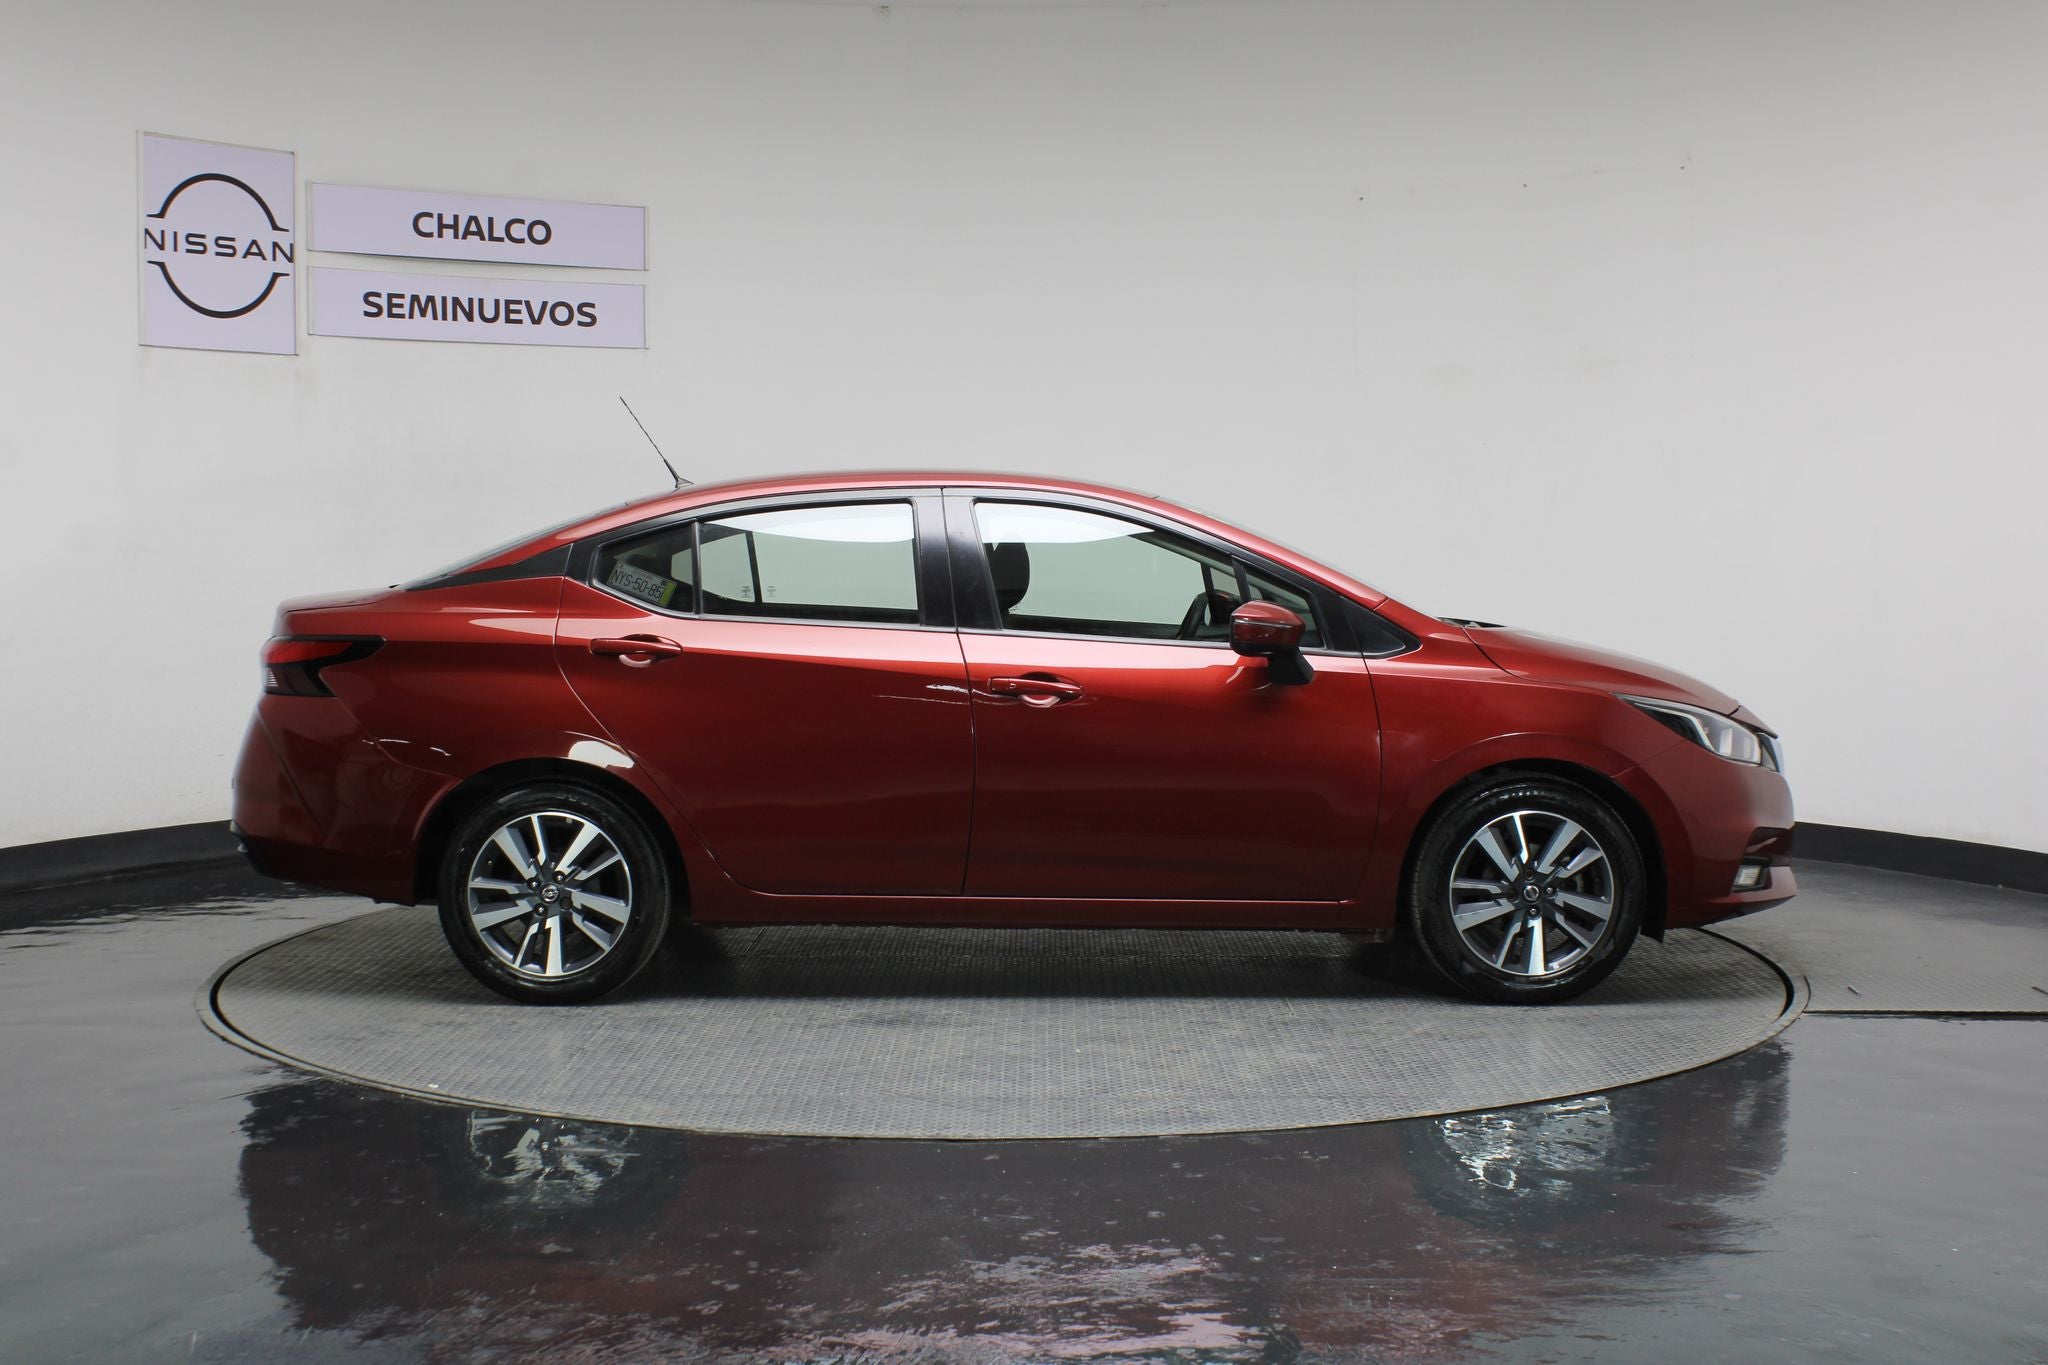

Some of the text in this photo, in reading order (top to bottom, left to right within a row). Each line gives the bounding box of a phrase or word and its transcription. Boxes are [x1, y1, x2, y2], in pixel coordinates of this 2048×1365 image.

[144, 228, 294, 263] NISSAN
[412, 211, 553, 246] CHALCO
[362, 291, 598, 328] SEMINUEVOS
[612, 569, 664, 599] NYS-50-85
